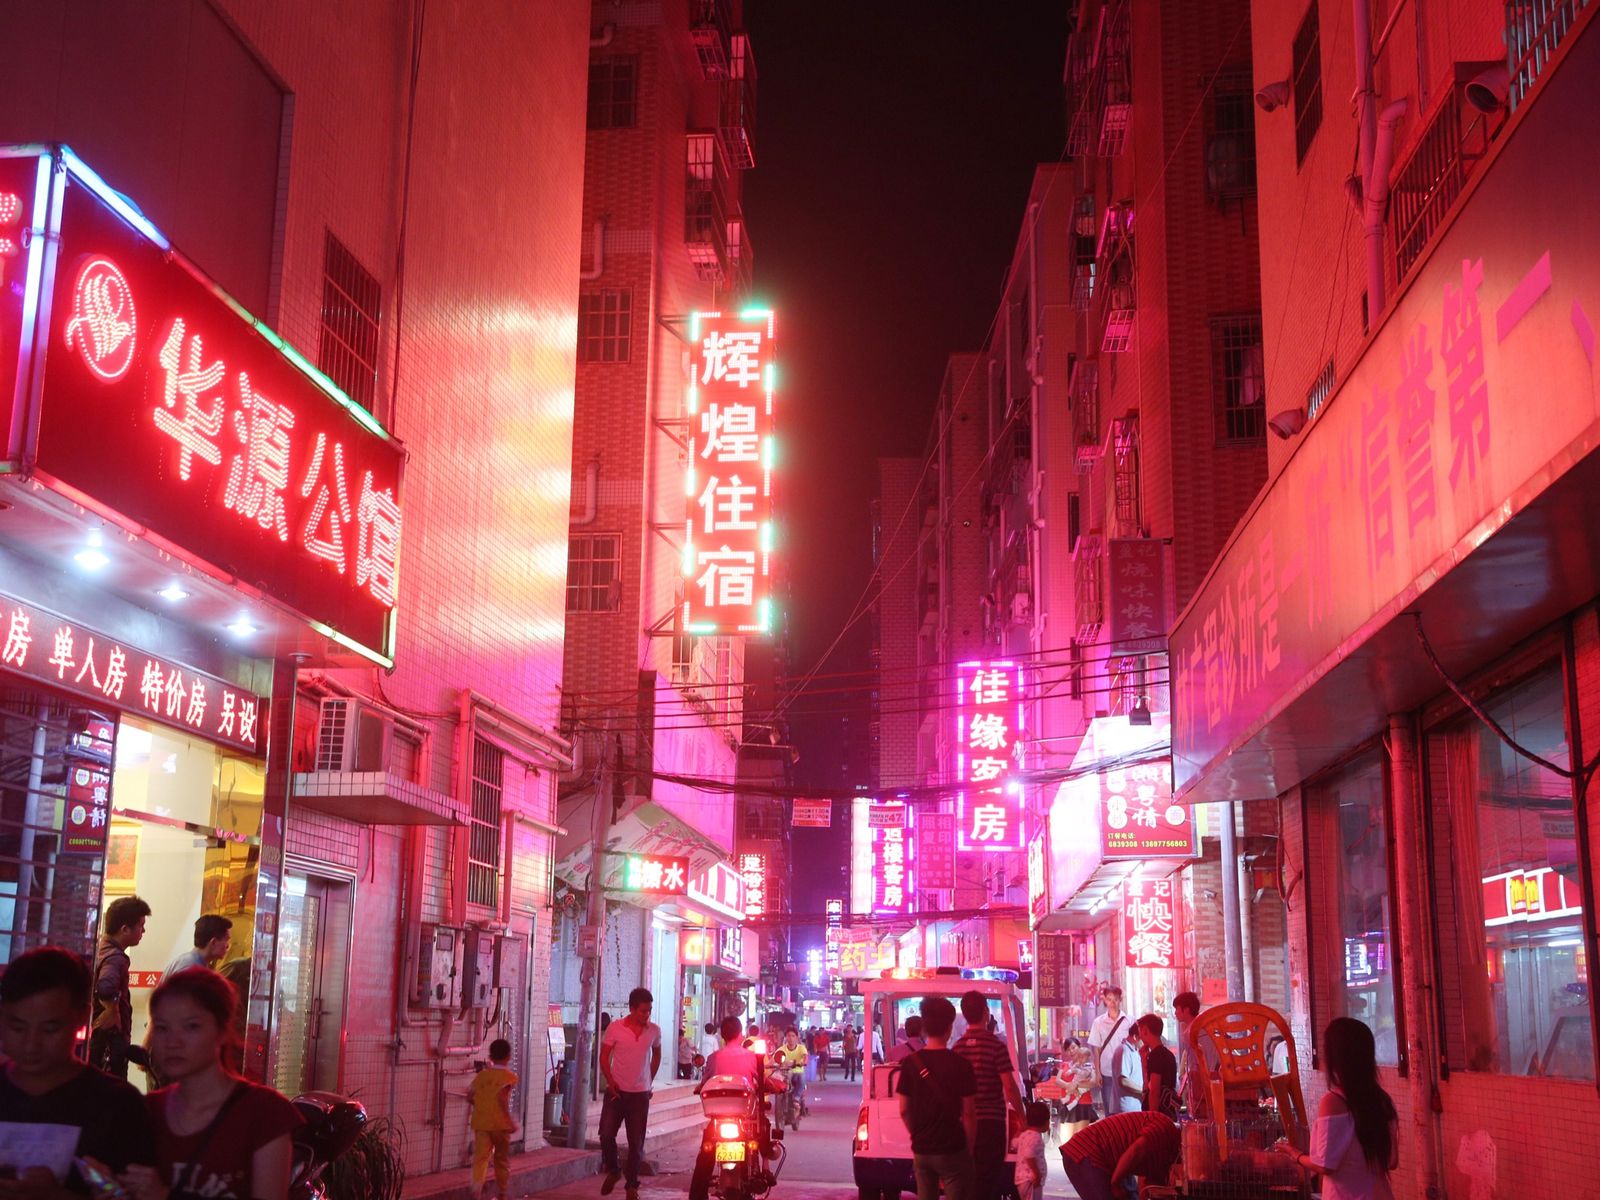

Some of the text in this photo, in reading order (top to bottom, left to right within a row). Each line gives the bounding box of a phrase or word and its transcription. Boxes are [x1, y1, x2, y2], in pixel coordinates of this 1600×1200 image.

[154, 318, 402, 607] 华源公馆
[696, 331, 761, 607] 辉煌住宿
[48, 626, 127, 700] 单人房
[140, 660, 207, 727] 特价房
[217, 690, 256, 743] 另设
[969, 669, 1009, 841] 佳缘客房
[1127, 897, 1173, 967] 快餐
